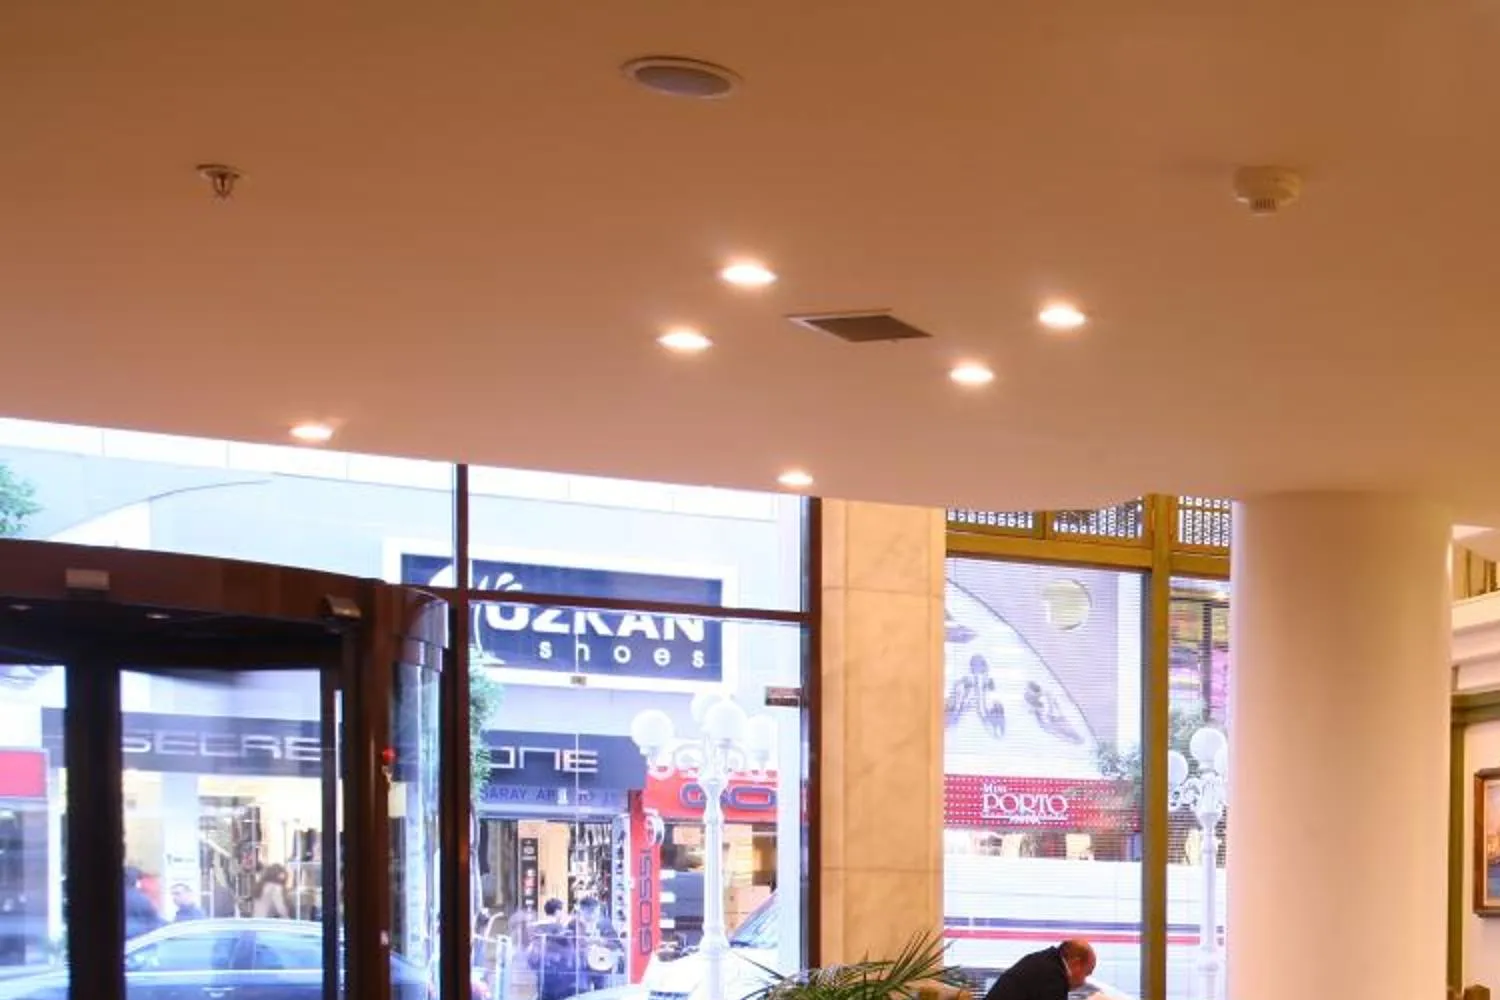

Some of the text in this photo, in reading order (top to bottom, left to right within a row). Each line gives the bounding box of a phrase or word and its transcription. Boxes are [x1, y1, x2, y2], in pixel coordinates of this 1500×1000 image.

[539, 641, 705, 669] shoes
[121, 729, 598, 773] SECRE ONE
[982, 793, 1068, 818] PORTO
[638, 848, 654, 956] GOSSI
